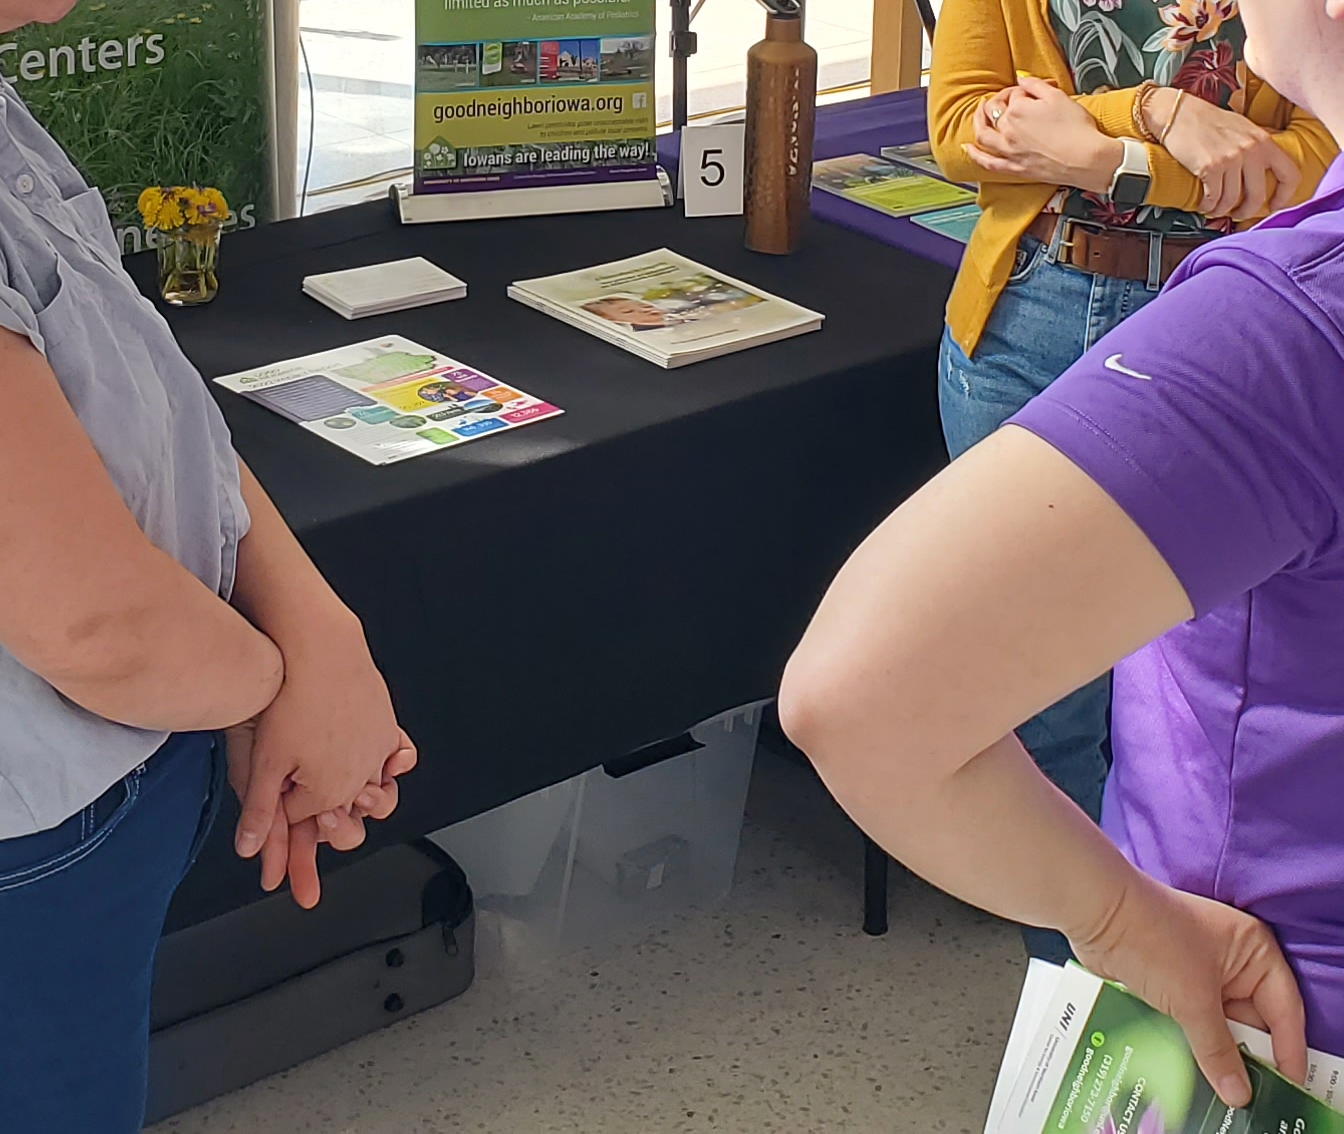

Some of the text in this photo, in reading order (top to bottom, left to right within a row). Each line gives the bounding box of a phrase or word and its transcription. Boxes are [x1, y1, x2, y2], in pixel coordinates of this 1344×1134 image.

[433, 94, 623, 124] goodneighboriowa.org
[463, 143, 650, 168] Iowans are leading the way!
[699, 149, 726, 187] 5
[1059, 1002, 1077, 1032] UNI
[1057, 1047, 1095, 1130] goodneighboriowa
[1122, 1077, 1146, 1125] CONTACT
